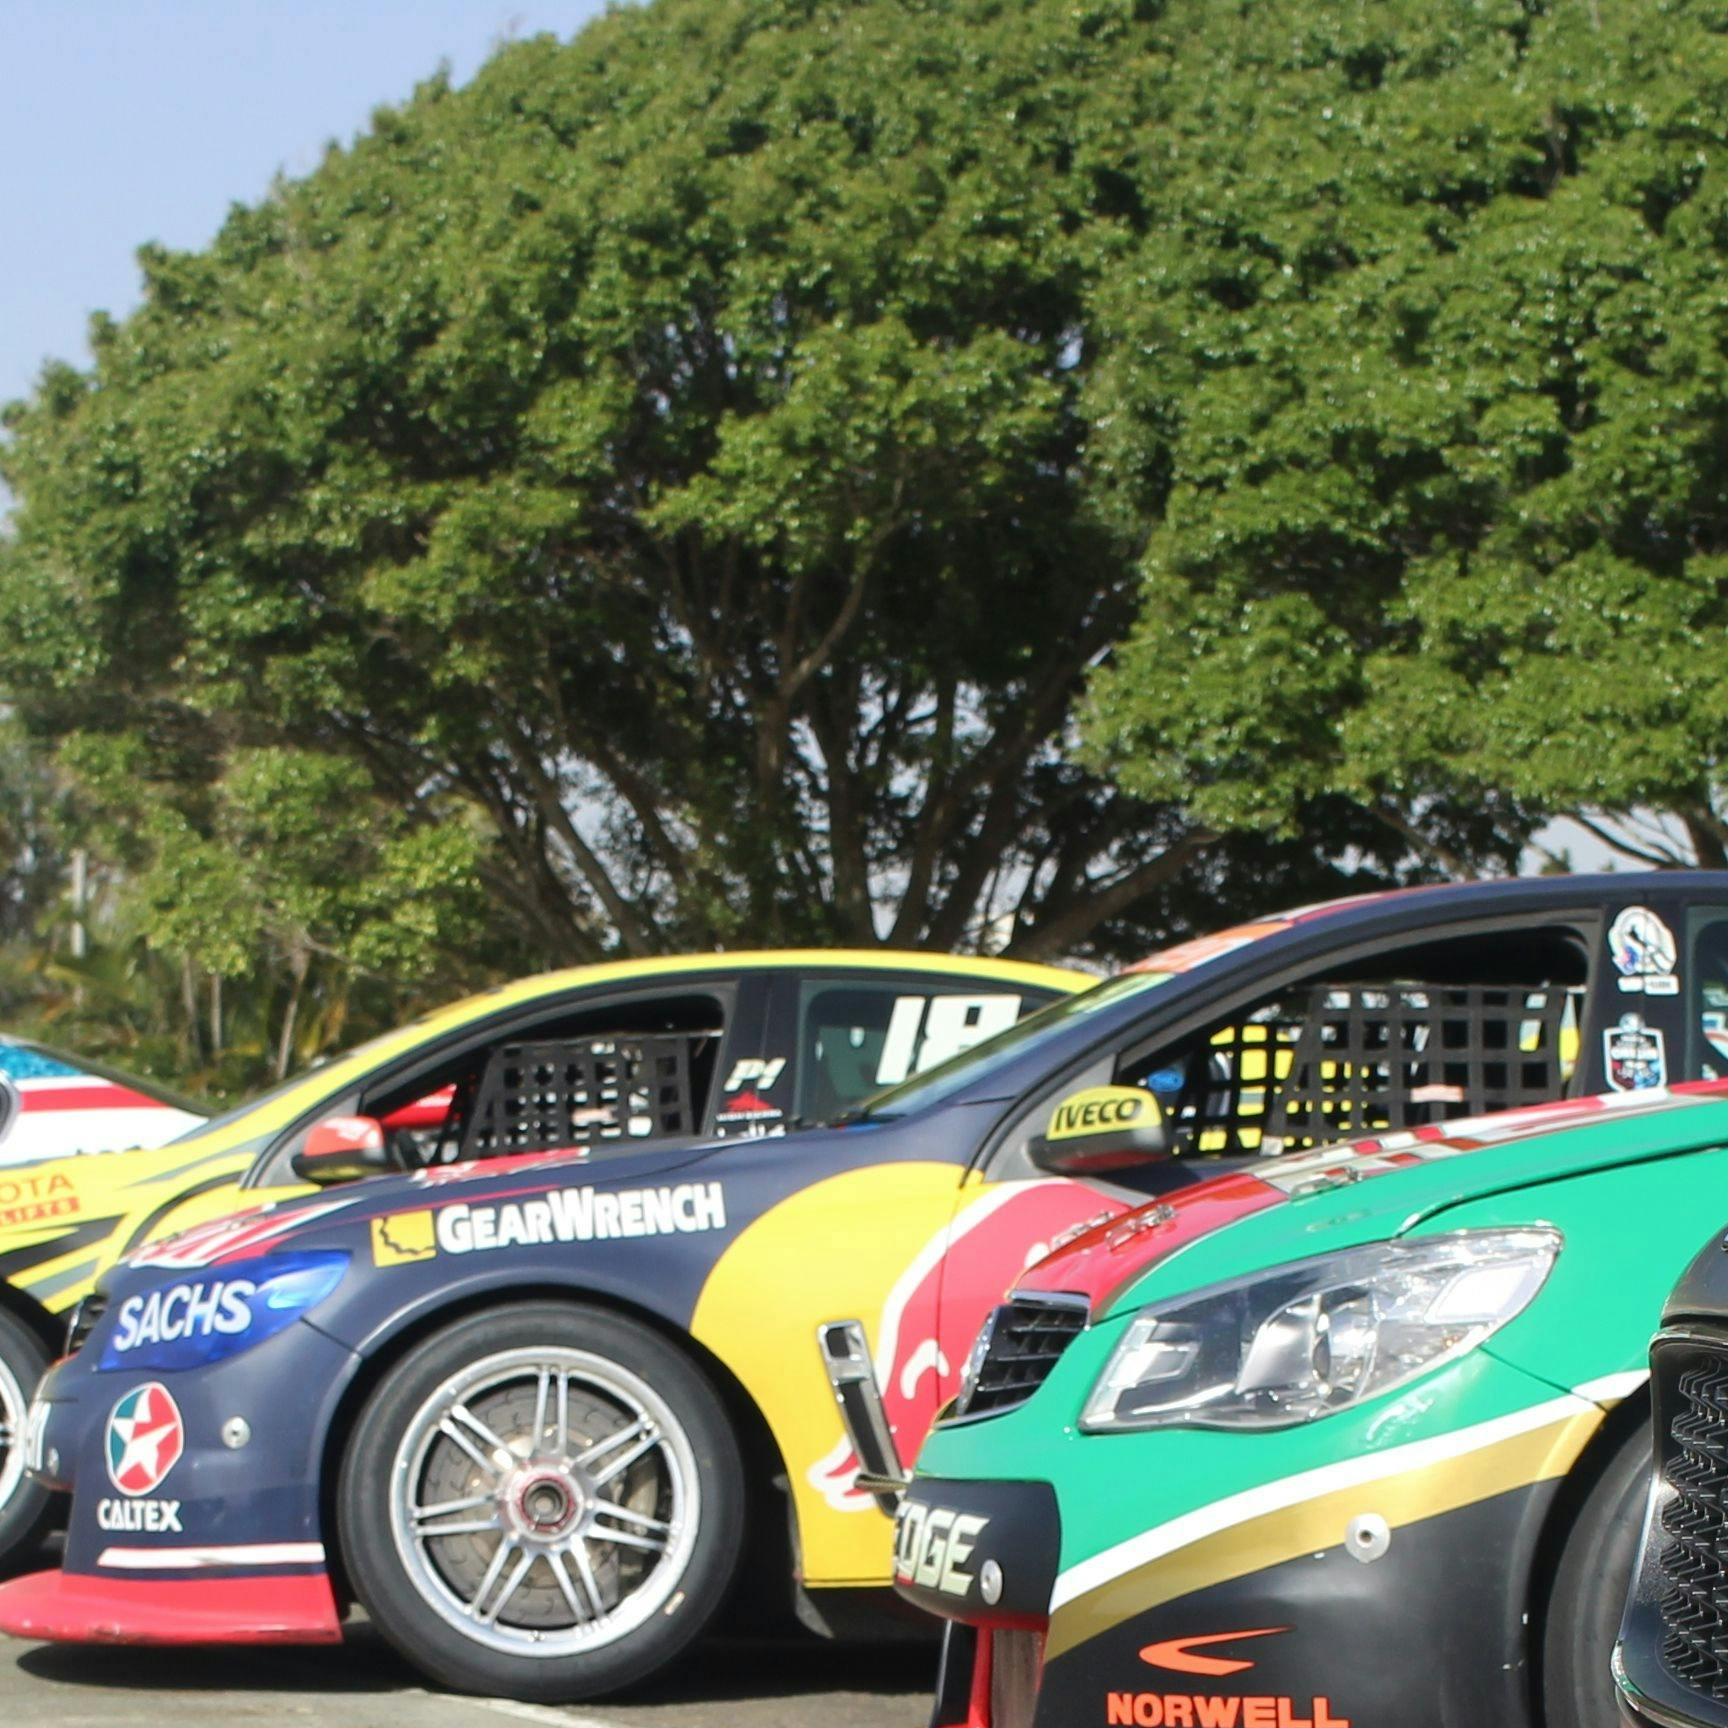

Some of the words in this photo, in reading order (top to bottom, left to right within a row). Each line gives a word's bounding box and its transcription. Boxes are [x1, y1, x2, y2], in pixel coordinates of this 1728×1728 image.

[1054, 1098, 1142, 1132] IVECO
[113, 1279, 256, 1352] SACHS
[97, 1498, 183, 1532] CALTEX
